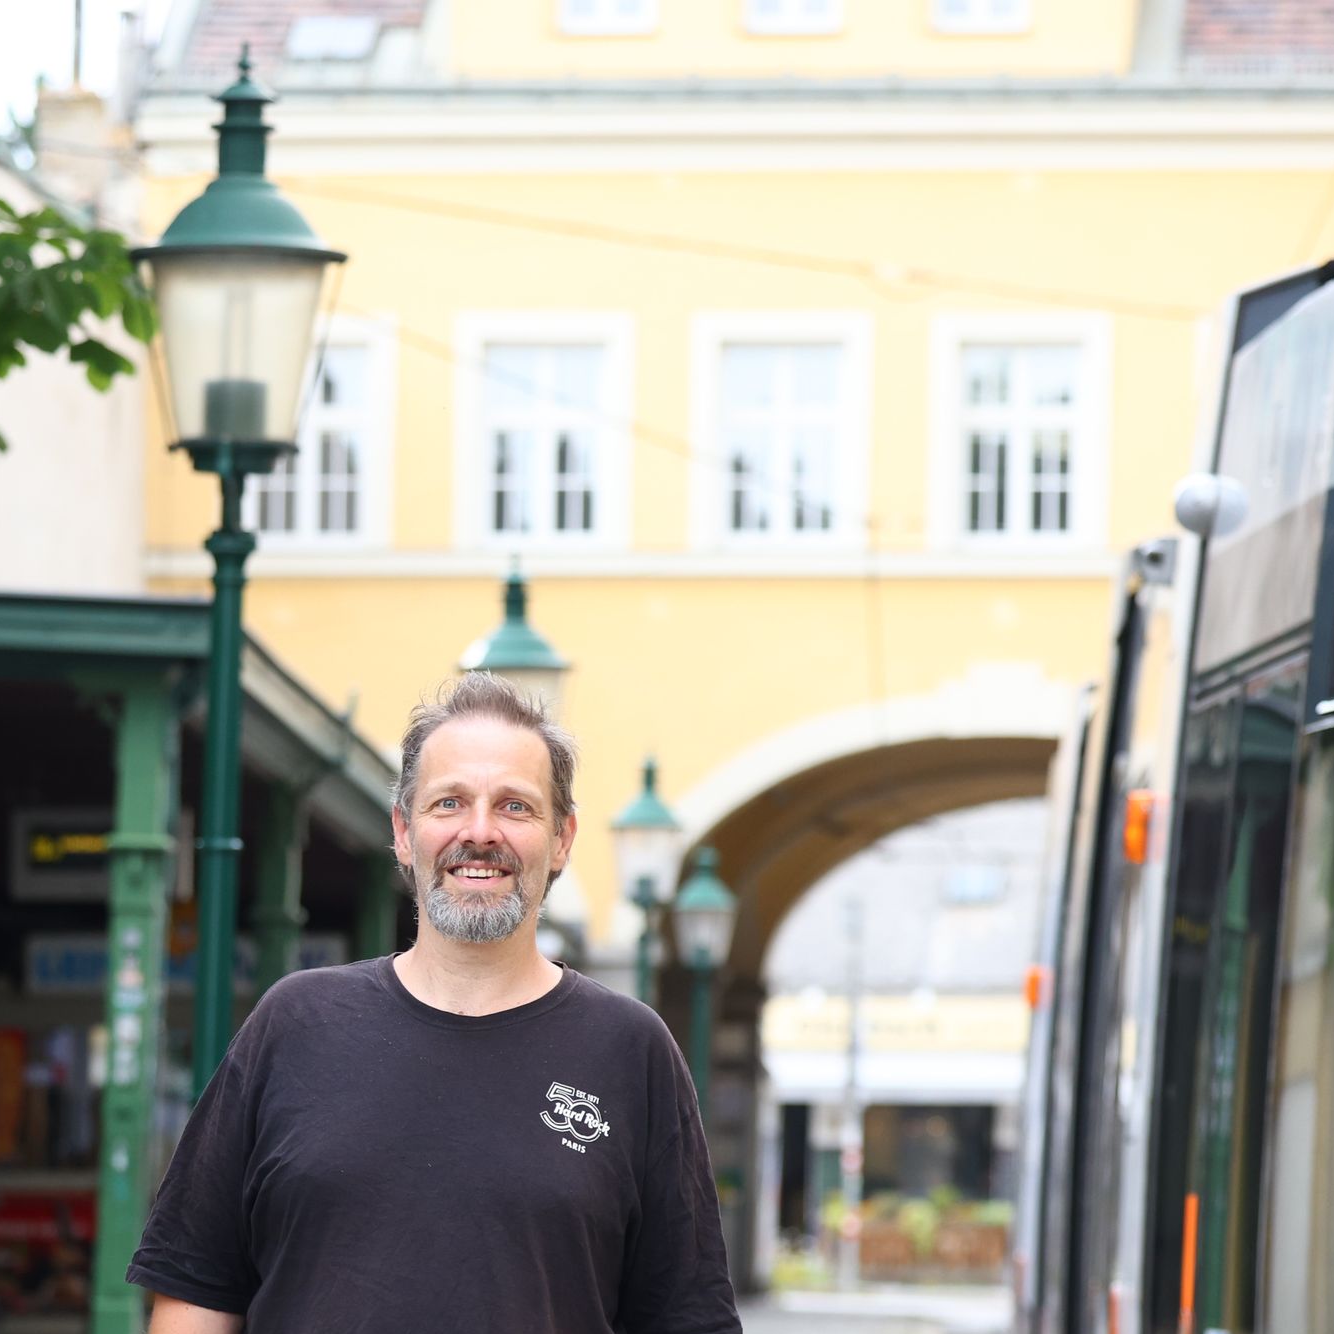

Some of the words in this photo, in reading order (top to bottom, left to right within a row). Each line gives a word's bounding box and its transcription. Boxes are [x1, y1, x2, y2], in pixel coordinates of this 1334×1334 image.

[553, 1102, 586, 1122] Hard
[584, 1112, 610, 1137] Rock
[561, 1138, 586, 1154] PARIS
